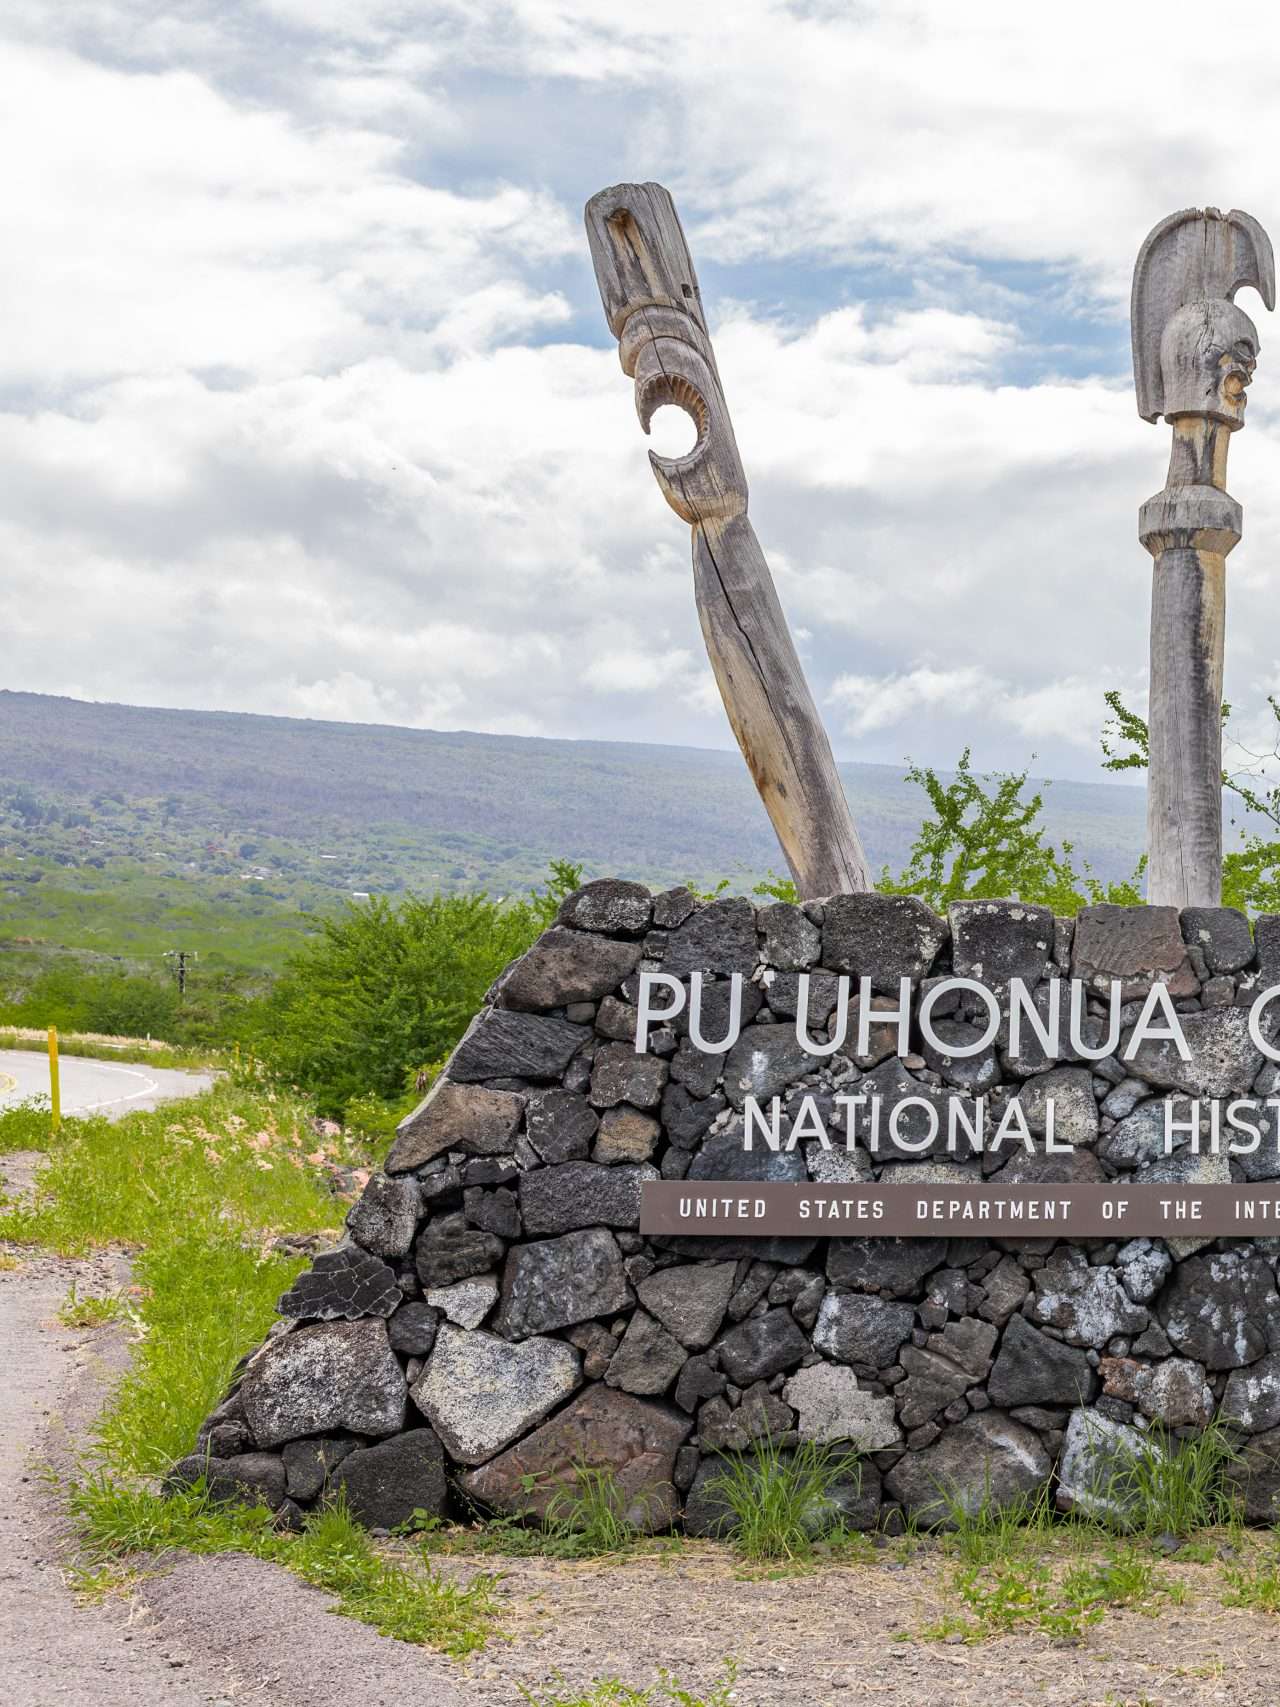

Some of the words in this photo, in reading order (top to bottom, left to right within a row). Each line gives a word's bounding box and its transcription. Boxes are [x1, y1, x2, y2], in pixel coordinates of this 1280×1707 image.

[742, 1095, 1075, 1154] NATIONAL
[678, 1198, 768, 1219] UNITED
[798, 1199, 885, 1220] STATES
[916, 1199, 1073, 1221] DEPARTMENT
[1101, 1200, 1130, 1220] OF
[1159, 1200, 1203, 1221] THE
